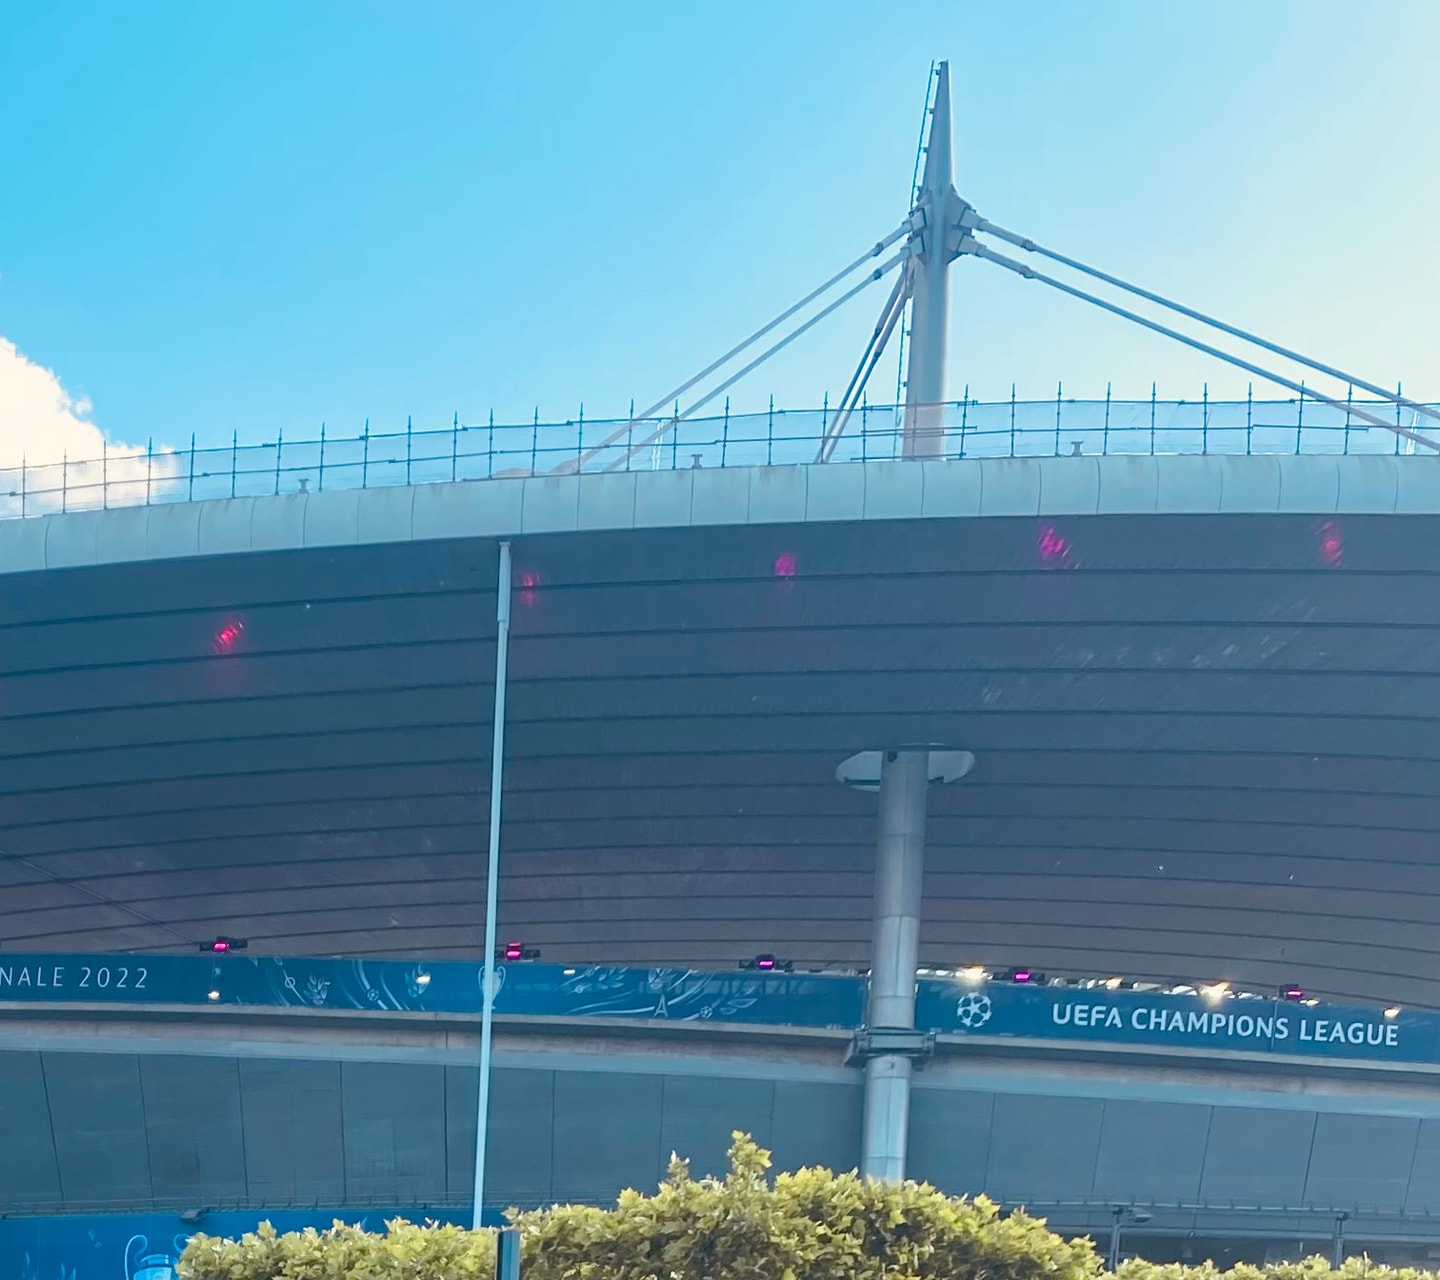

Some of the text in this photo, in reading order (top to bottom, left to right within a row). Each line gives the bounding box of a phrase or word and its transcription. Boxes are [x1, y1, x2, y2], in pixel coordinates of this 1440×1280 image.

[79, 967, 147, 988] 2022
[1052, 1003, 1400, 1046] UEFA CHAMPIONS LEAGUE
